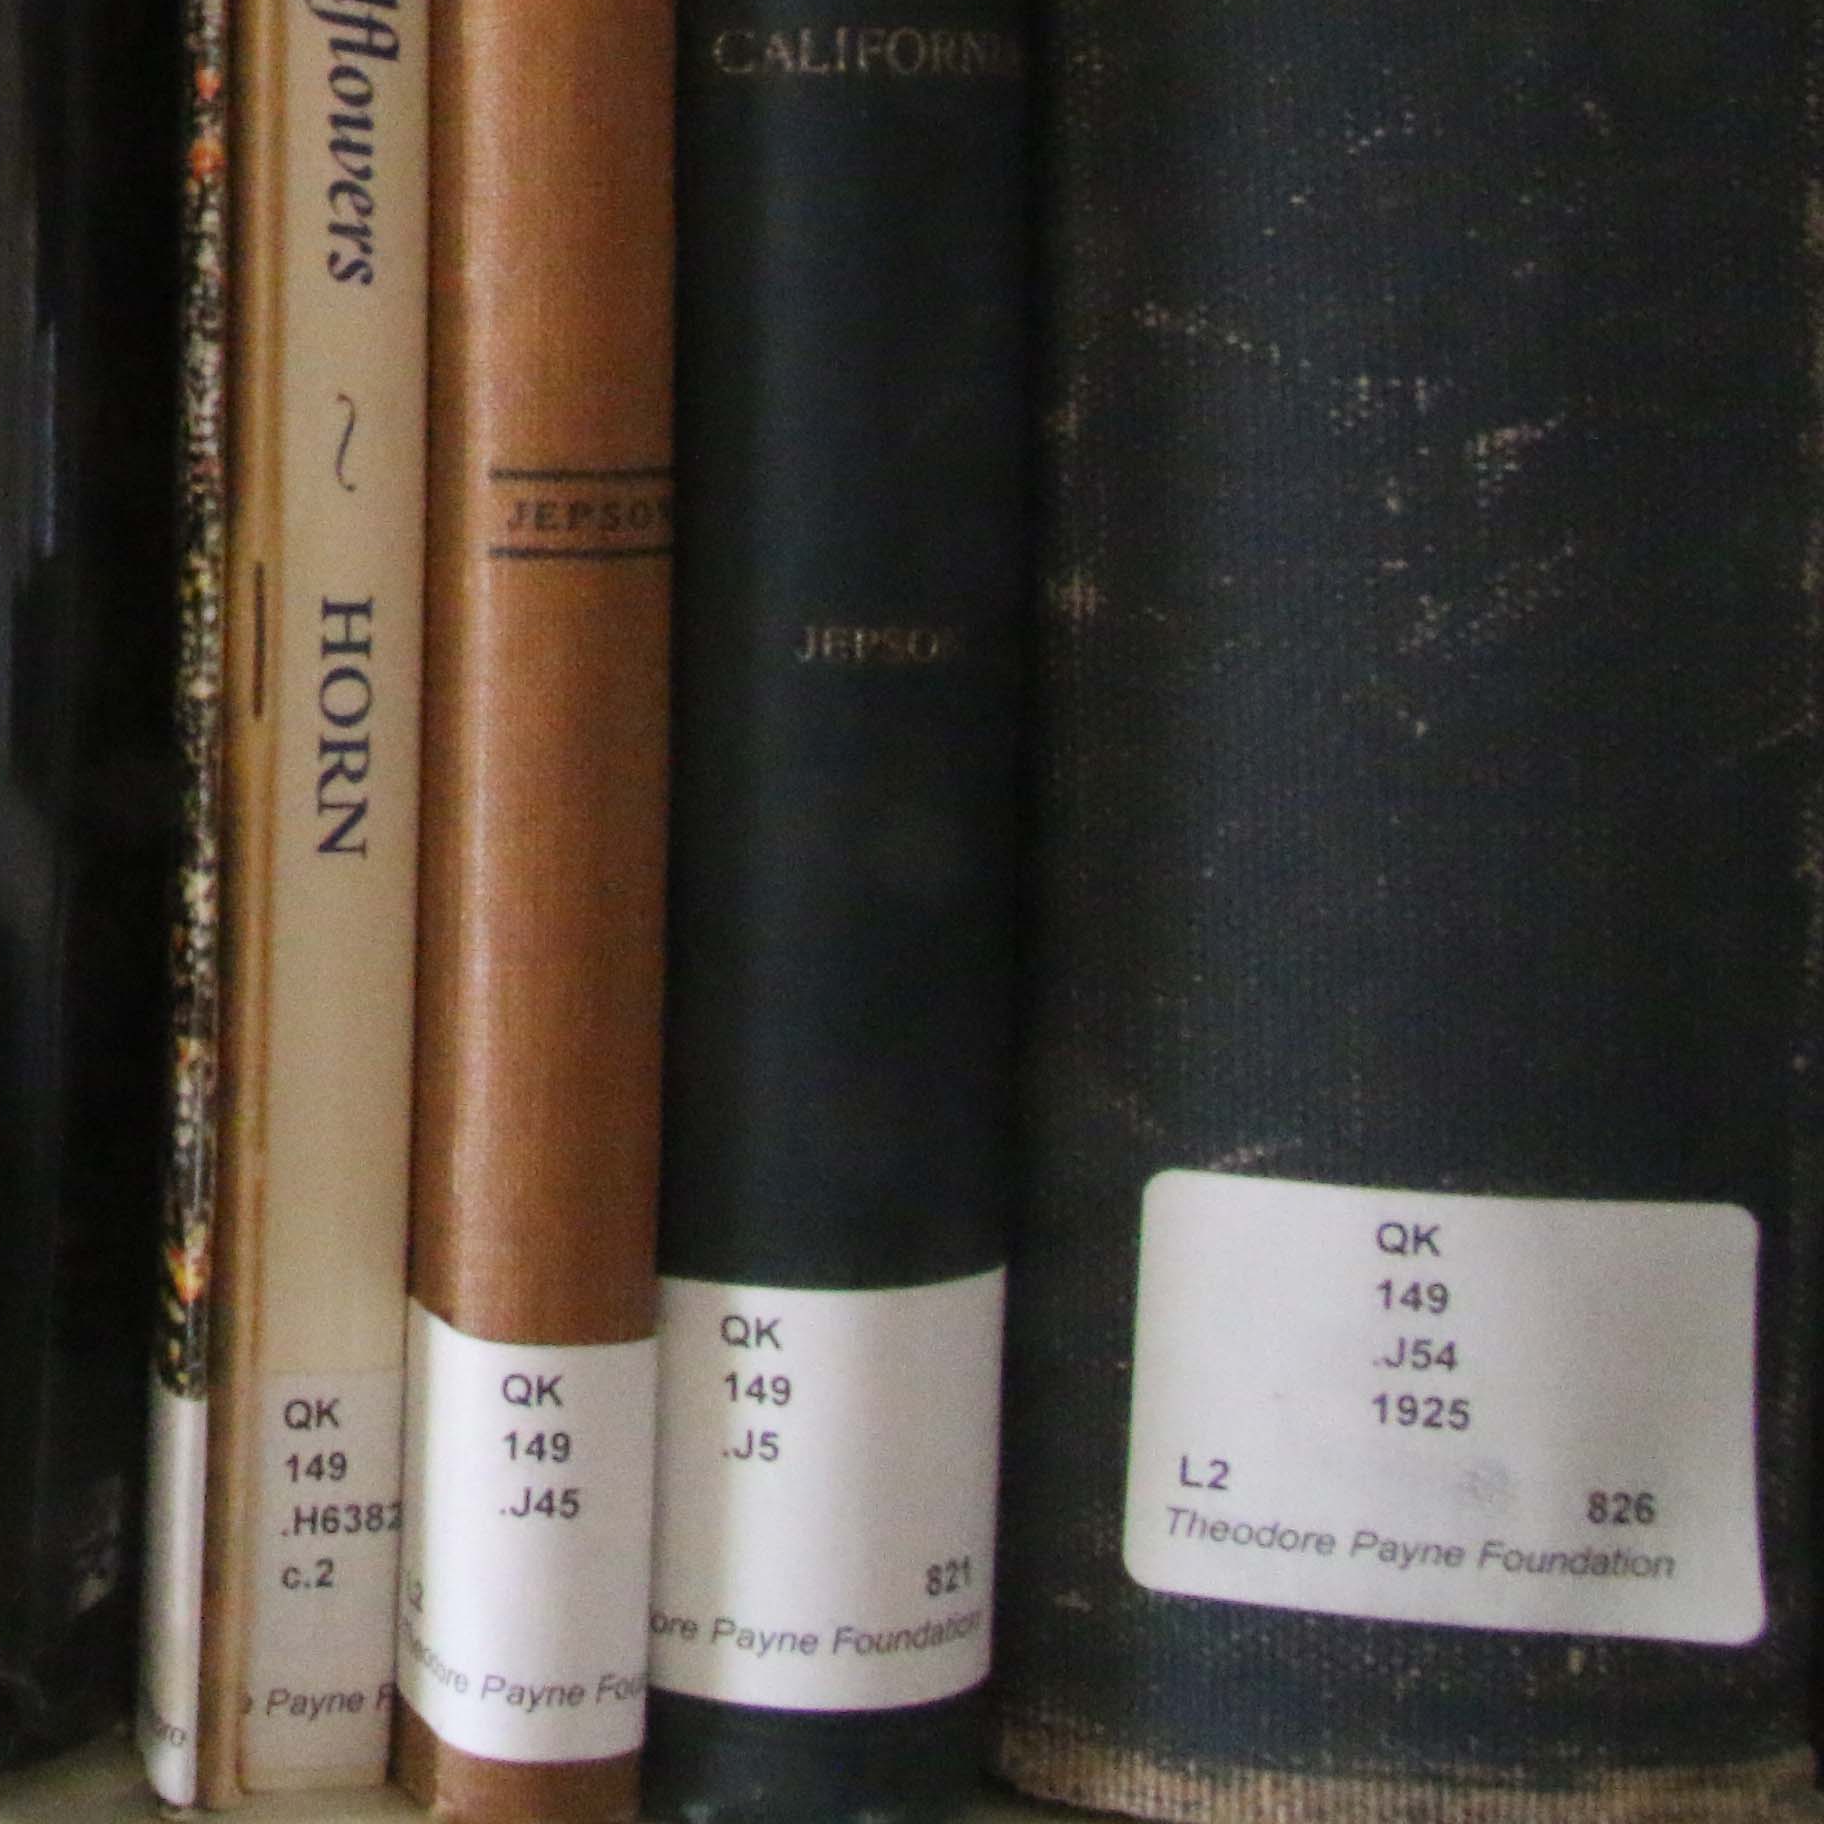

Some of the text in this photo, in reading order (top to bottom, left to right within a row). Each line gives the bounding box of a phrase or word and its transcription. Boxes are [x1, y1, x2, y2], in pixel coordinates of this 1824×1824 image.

[315, 595, 374, 860] HORN
[1375, 1220, 1441, 1258] QK
[1376, 1279, 1450, 1316] 149
[720, 1314, 784, 1350] QK
[1371, 1335, 1459, 1373] .J54
[501, 1373, 564, 1408] QK
[723, 1373, 792, 1407] 149
[284, 1398, 341, 1430] QK
[1371, 1392, 1471, 1432] 1925
[501, 1432, 572, 1465] 149
[723, 1430, 780, 1462] .J5
[286, 1452, 348, 1483] 149
[1178, 1454, 1230, 1491] L2
[499, 1488, 581, 1520] .J45
[1585, 1490, 1656, 1527] 826
[1165, 1504, 1676, 1581] Theodore Payne Foundation
[282, 1558, 335, 1591] c.2
[711, 1616, 820, 1658] Payne
[266, 1687, 364, 1722] Payne
[480, 1674, 586, 1714] Payne
